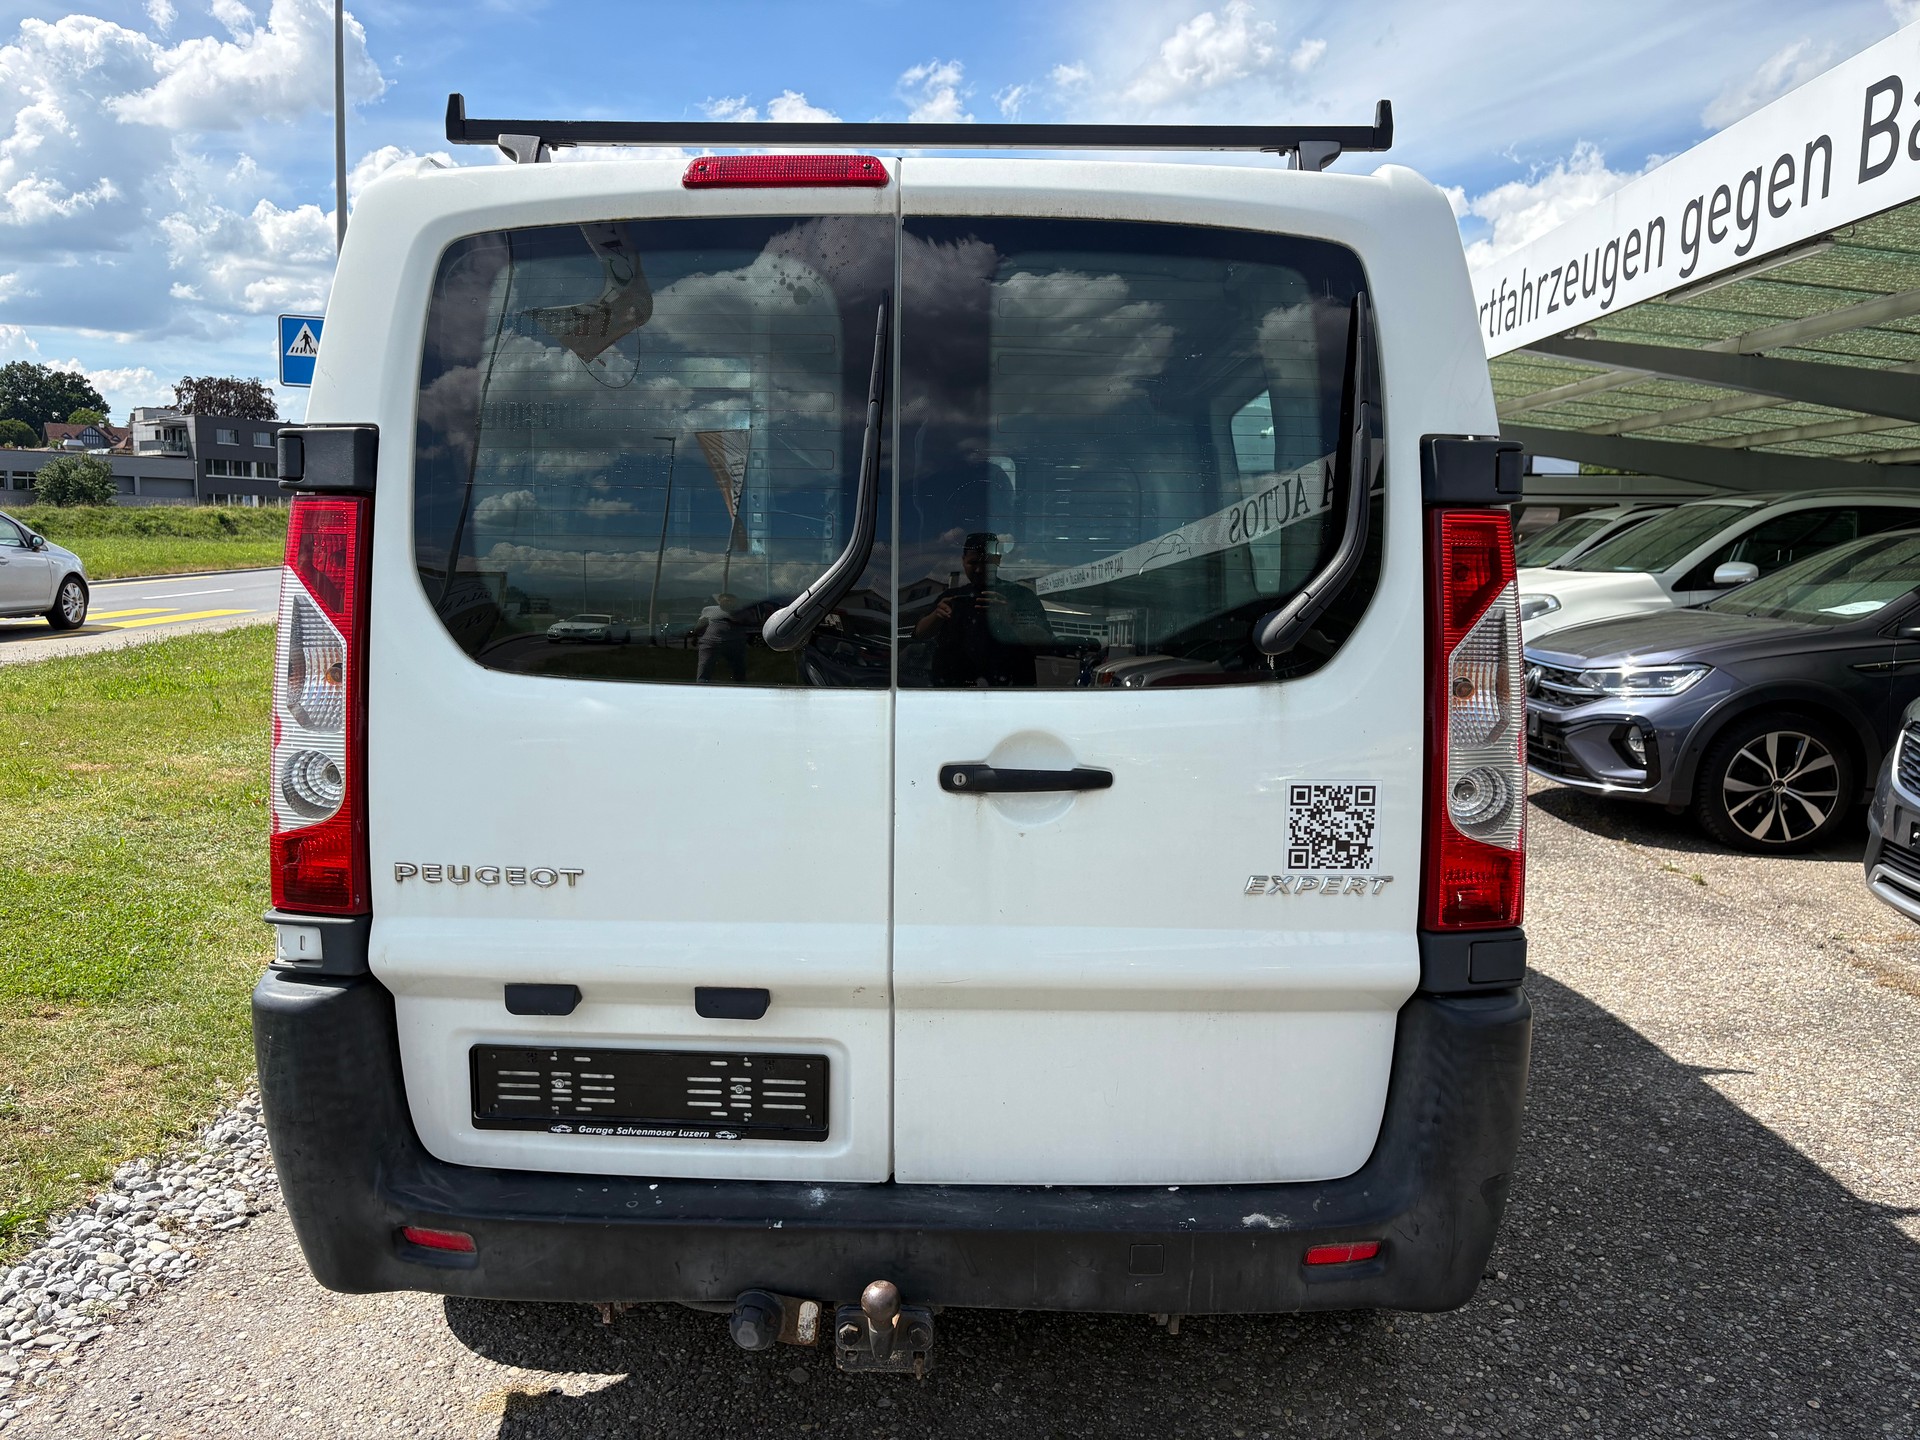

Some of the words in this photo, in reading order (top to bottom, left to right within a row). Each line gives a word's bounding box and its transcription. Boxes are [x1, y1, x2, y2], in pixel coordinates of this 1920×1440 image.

[1678, 134, 1832, 279] gegen
[394, 862, 584, 887] PEUGEOT
[1244, 875, 1394, 895] EXPERT
[578, 1125, 614, 1136] Garage
[616, 1126, 676, 1137] Salvenmoser
[678, 1129, 710, 1138] Luzern
